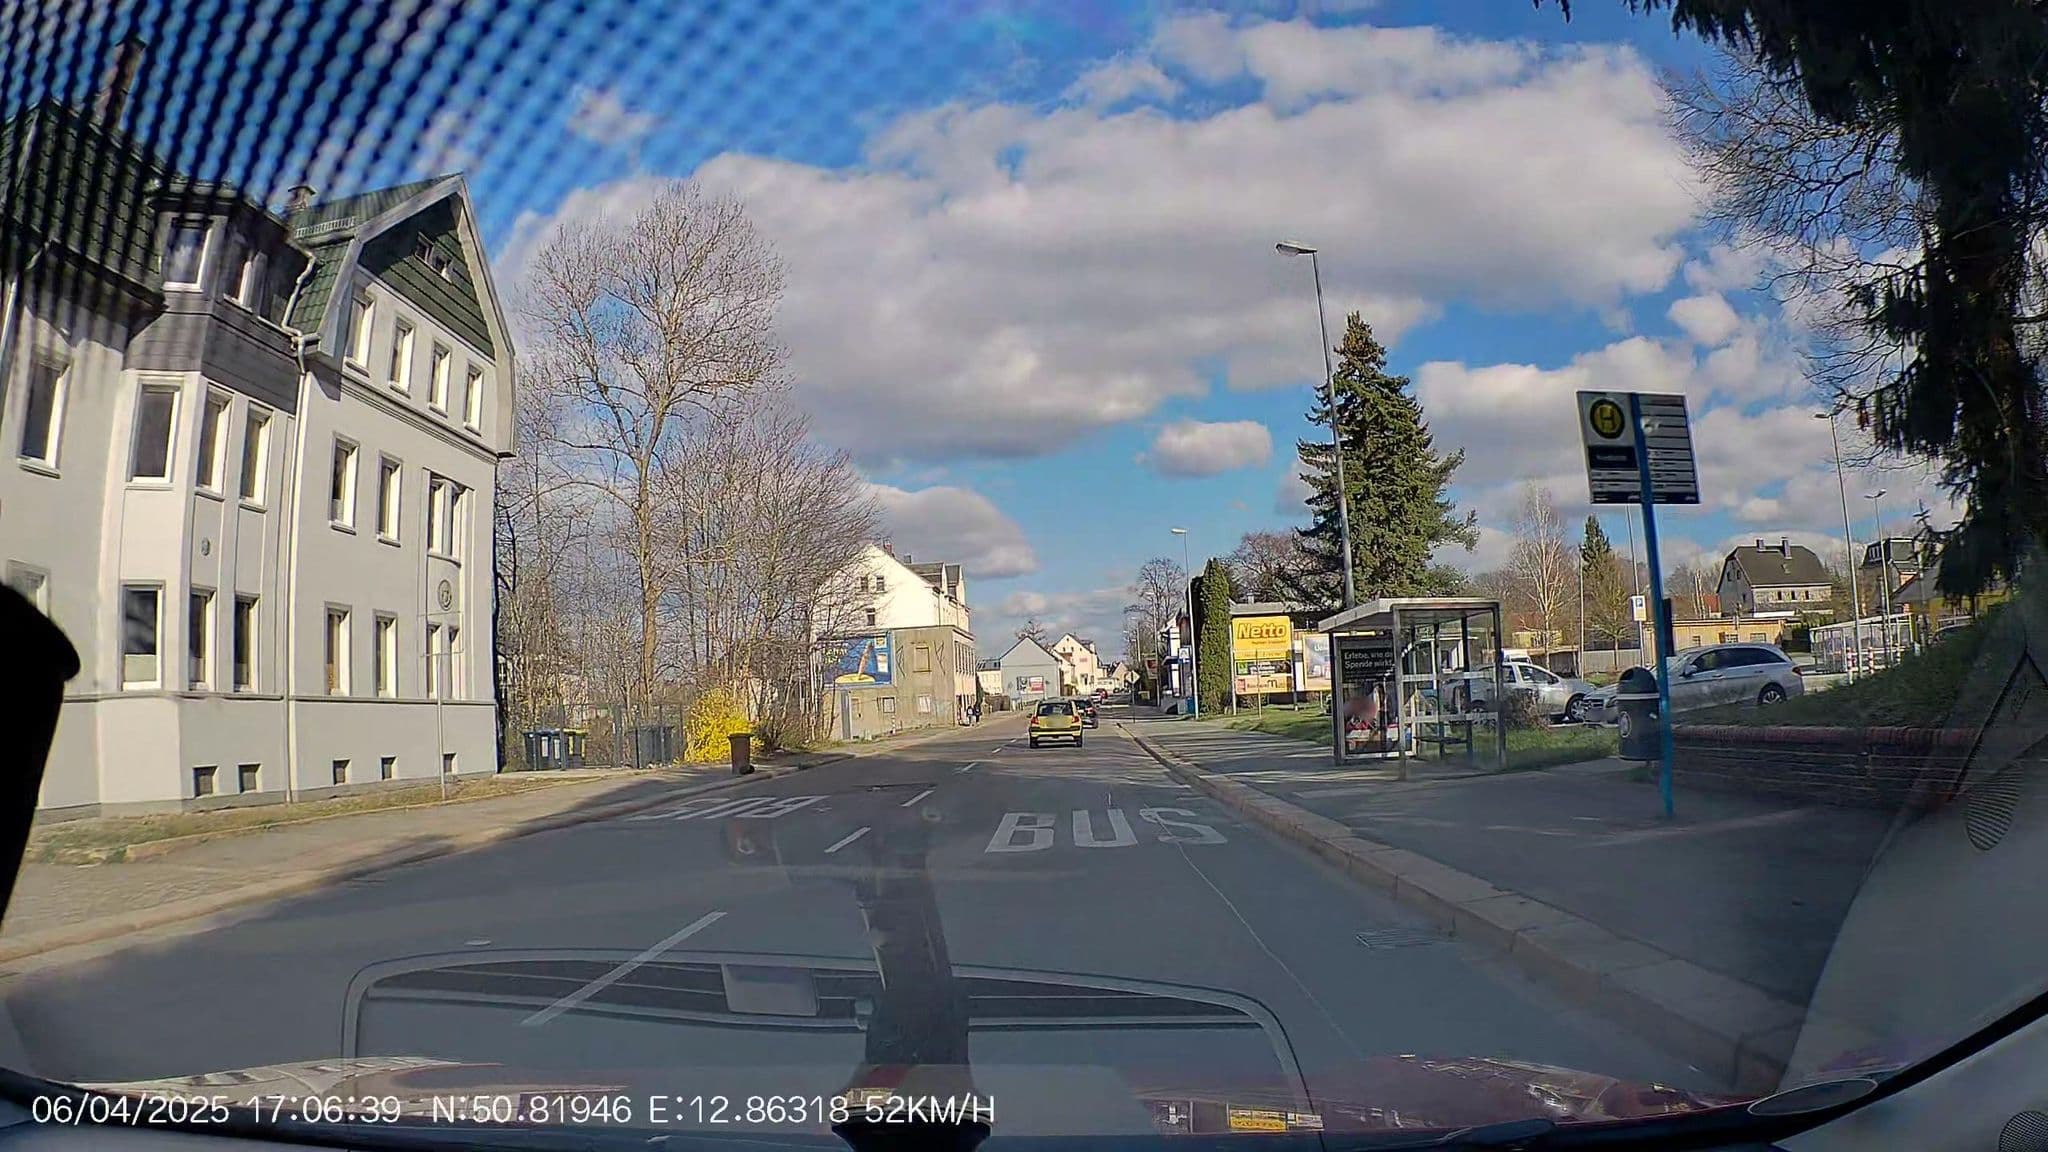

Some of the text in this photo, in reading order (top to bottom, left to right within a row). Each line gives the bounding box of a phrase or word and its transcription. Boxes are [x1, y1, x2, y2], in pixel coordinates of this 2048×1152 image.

[1600, 405, 1615, 432] H
[1238, 623, 1287, 639] Netto
[1345, 659, 1373, 669] Spende
[985, 807, 1228, 853] BUS
